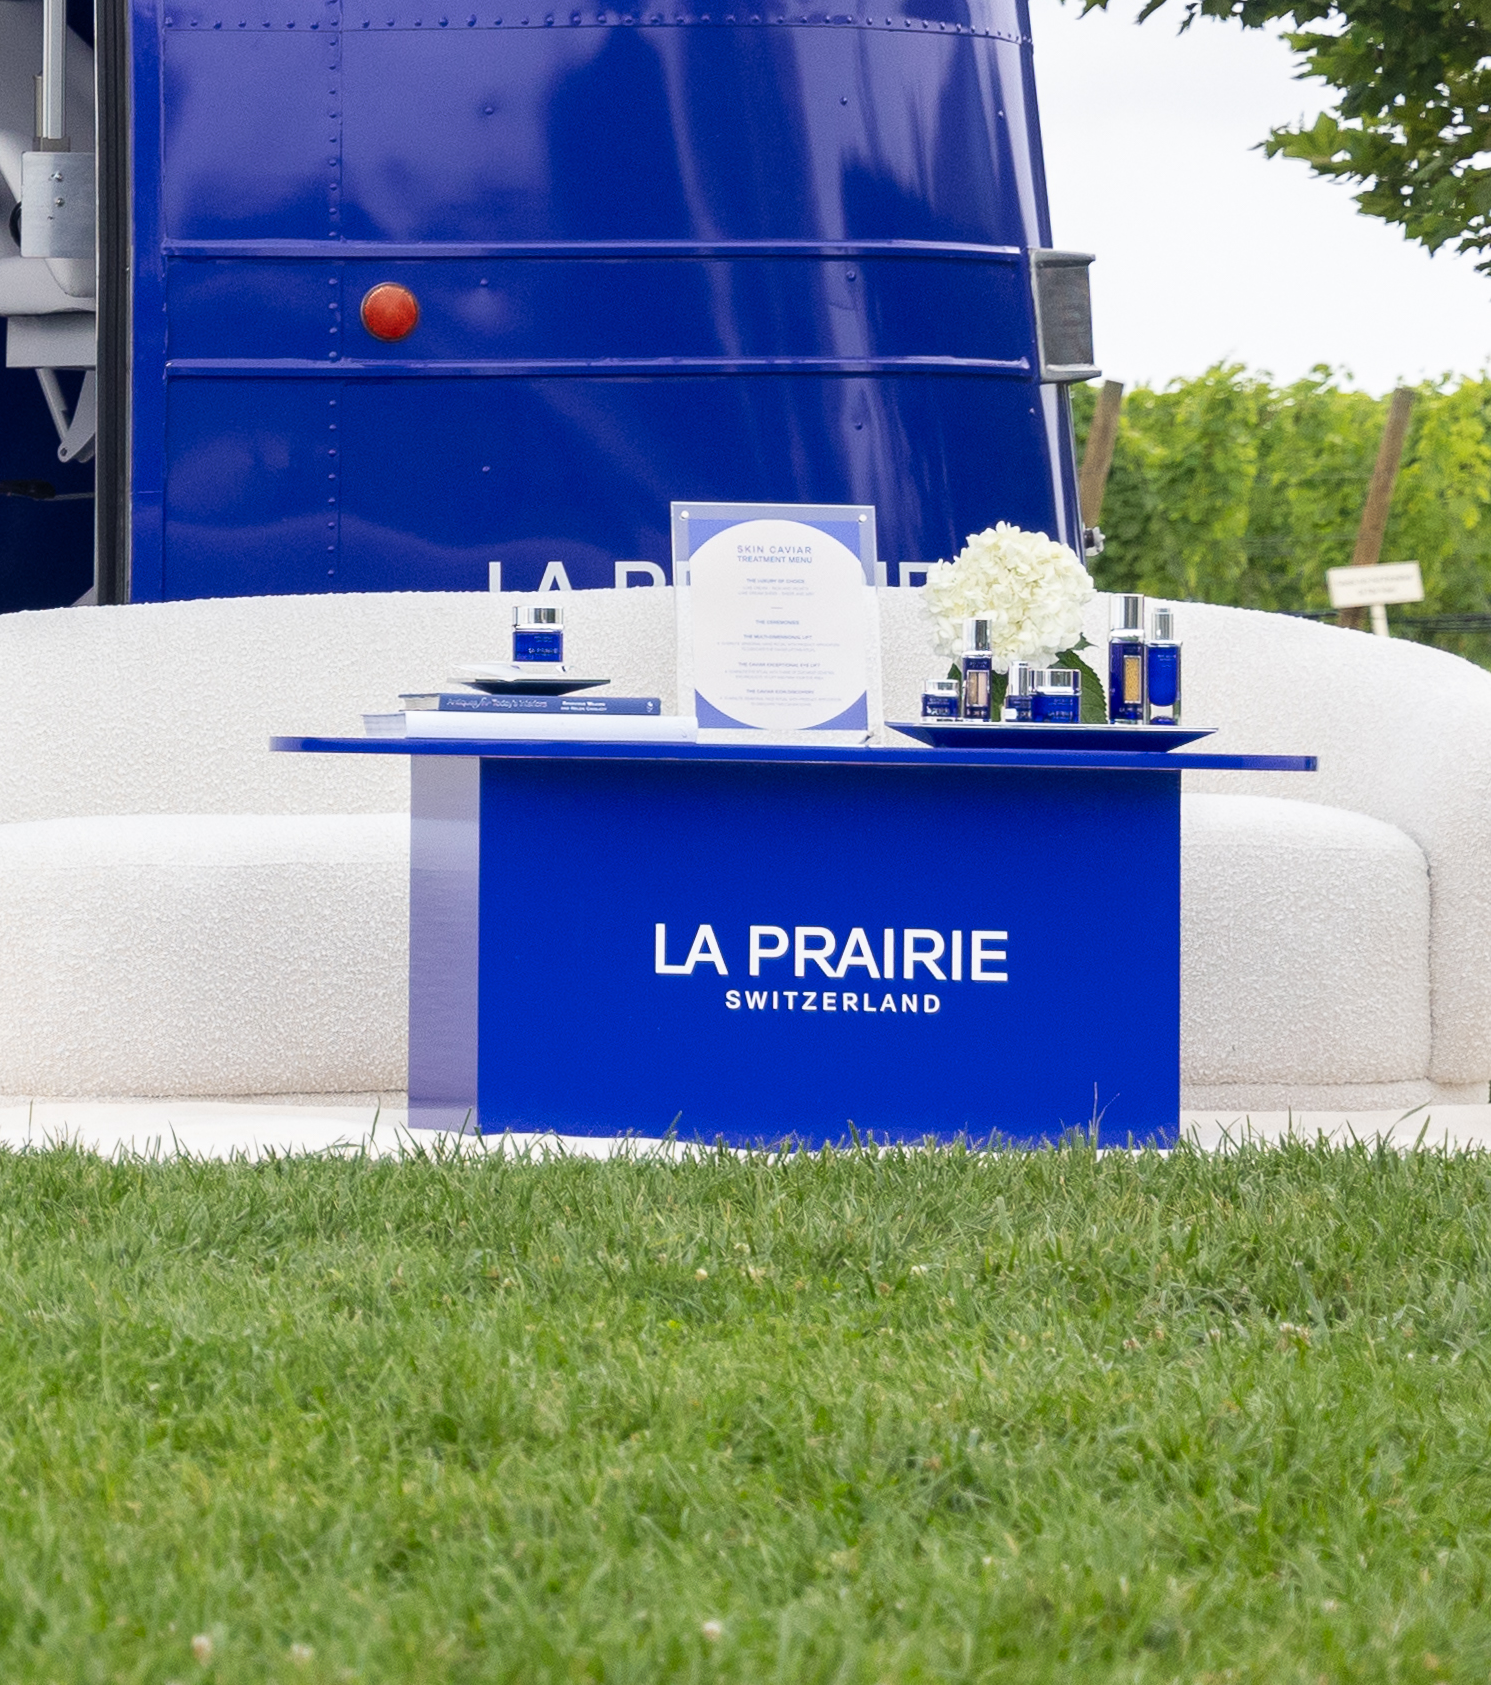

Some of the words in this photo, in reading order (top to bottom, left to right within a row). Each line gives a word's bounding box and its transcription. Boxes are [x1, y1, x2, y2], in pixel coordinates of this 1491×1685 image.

[737, 545, 764, 554] SKIN
[769, 546, 812, 554] CAVIAR
[737, 555, 786, 563] TREATMENT
[788, 556, 813, 564] MENU
[655, 923, 729, 976] LA
[749, 925, 1009, 982] PRAIRIE
[725, 989, 941, 1013] SWITZERLAND
